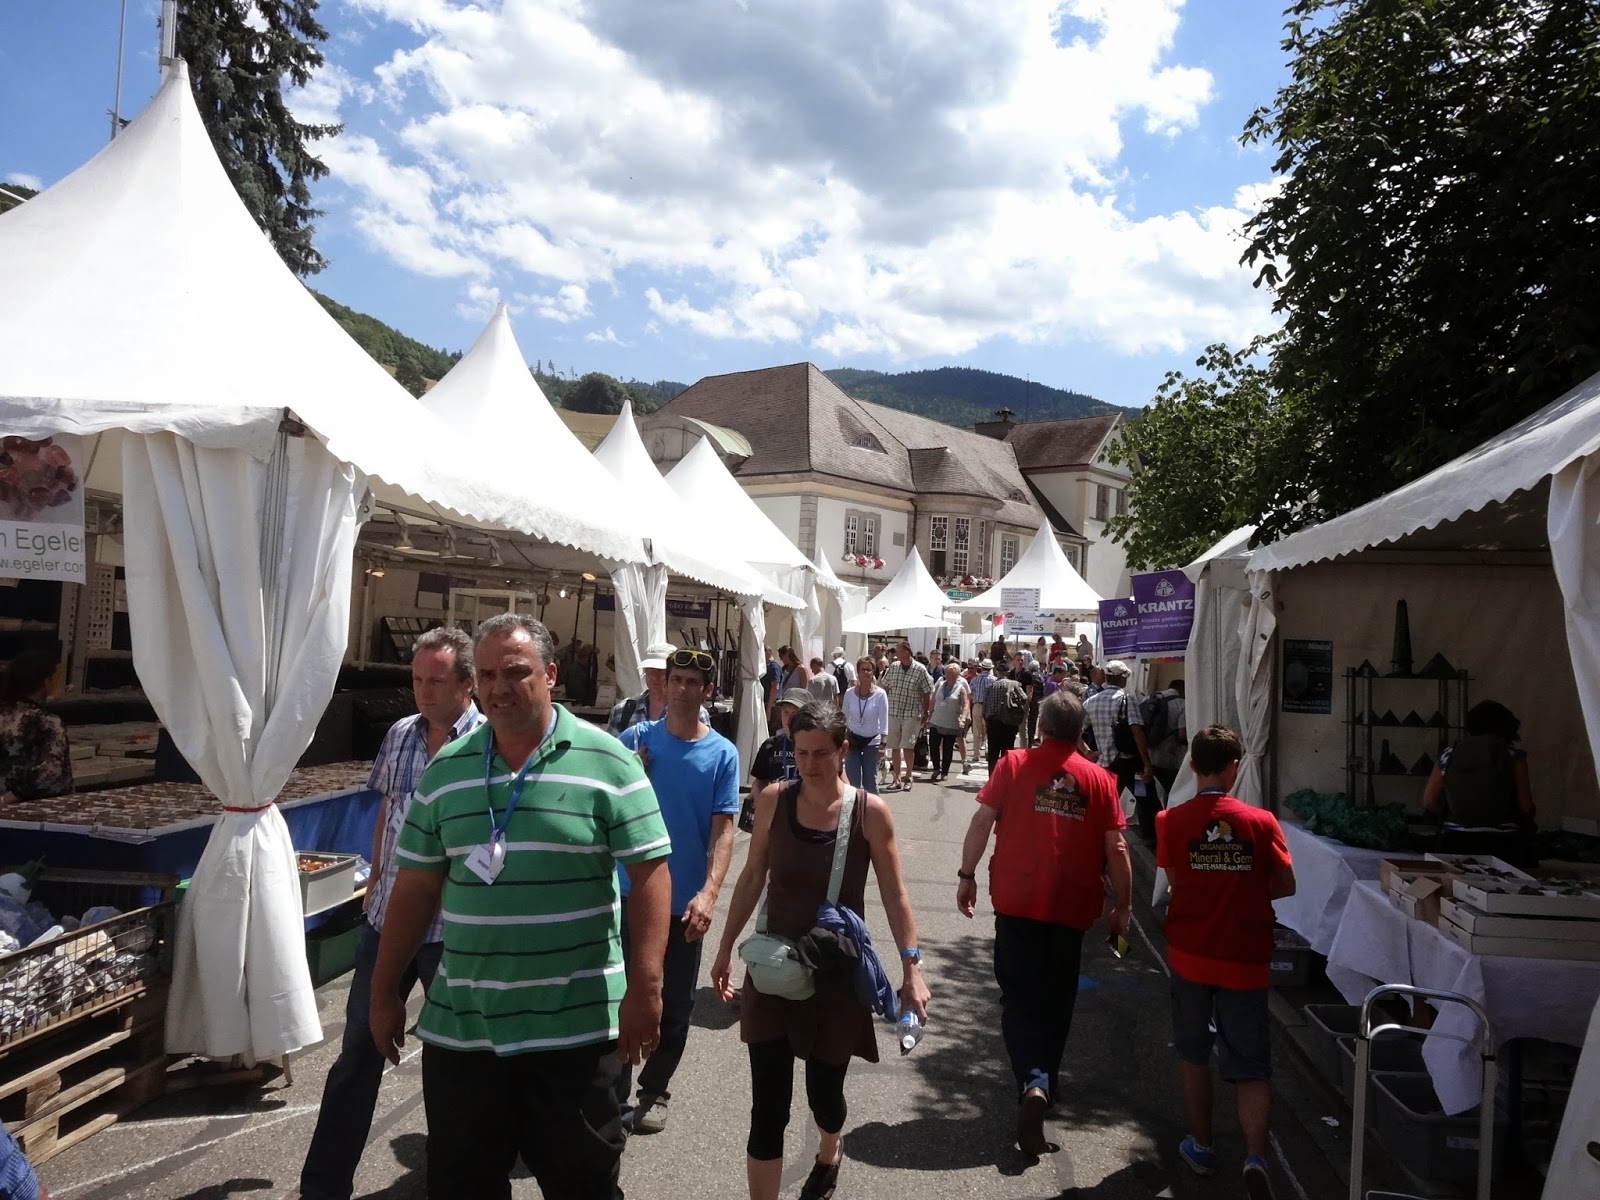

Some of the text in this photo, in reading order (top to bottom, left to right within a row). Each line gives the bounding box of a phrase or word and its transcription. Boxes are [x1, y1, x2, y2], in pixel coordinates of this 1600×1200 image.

[1138, 599, 1194, 614] KRANTZ
[1035, 795, 1086, 815] Mineral & Gem
[1199, 843, 1243, 851] ORGANISATION
[1189, 851, 1253, 864] Mineral & Gem
